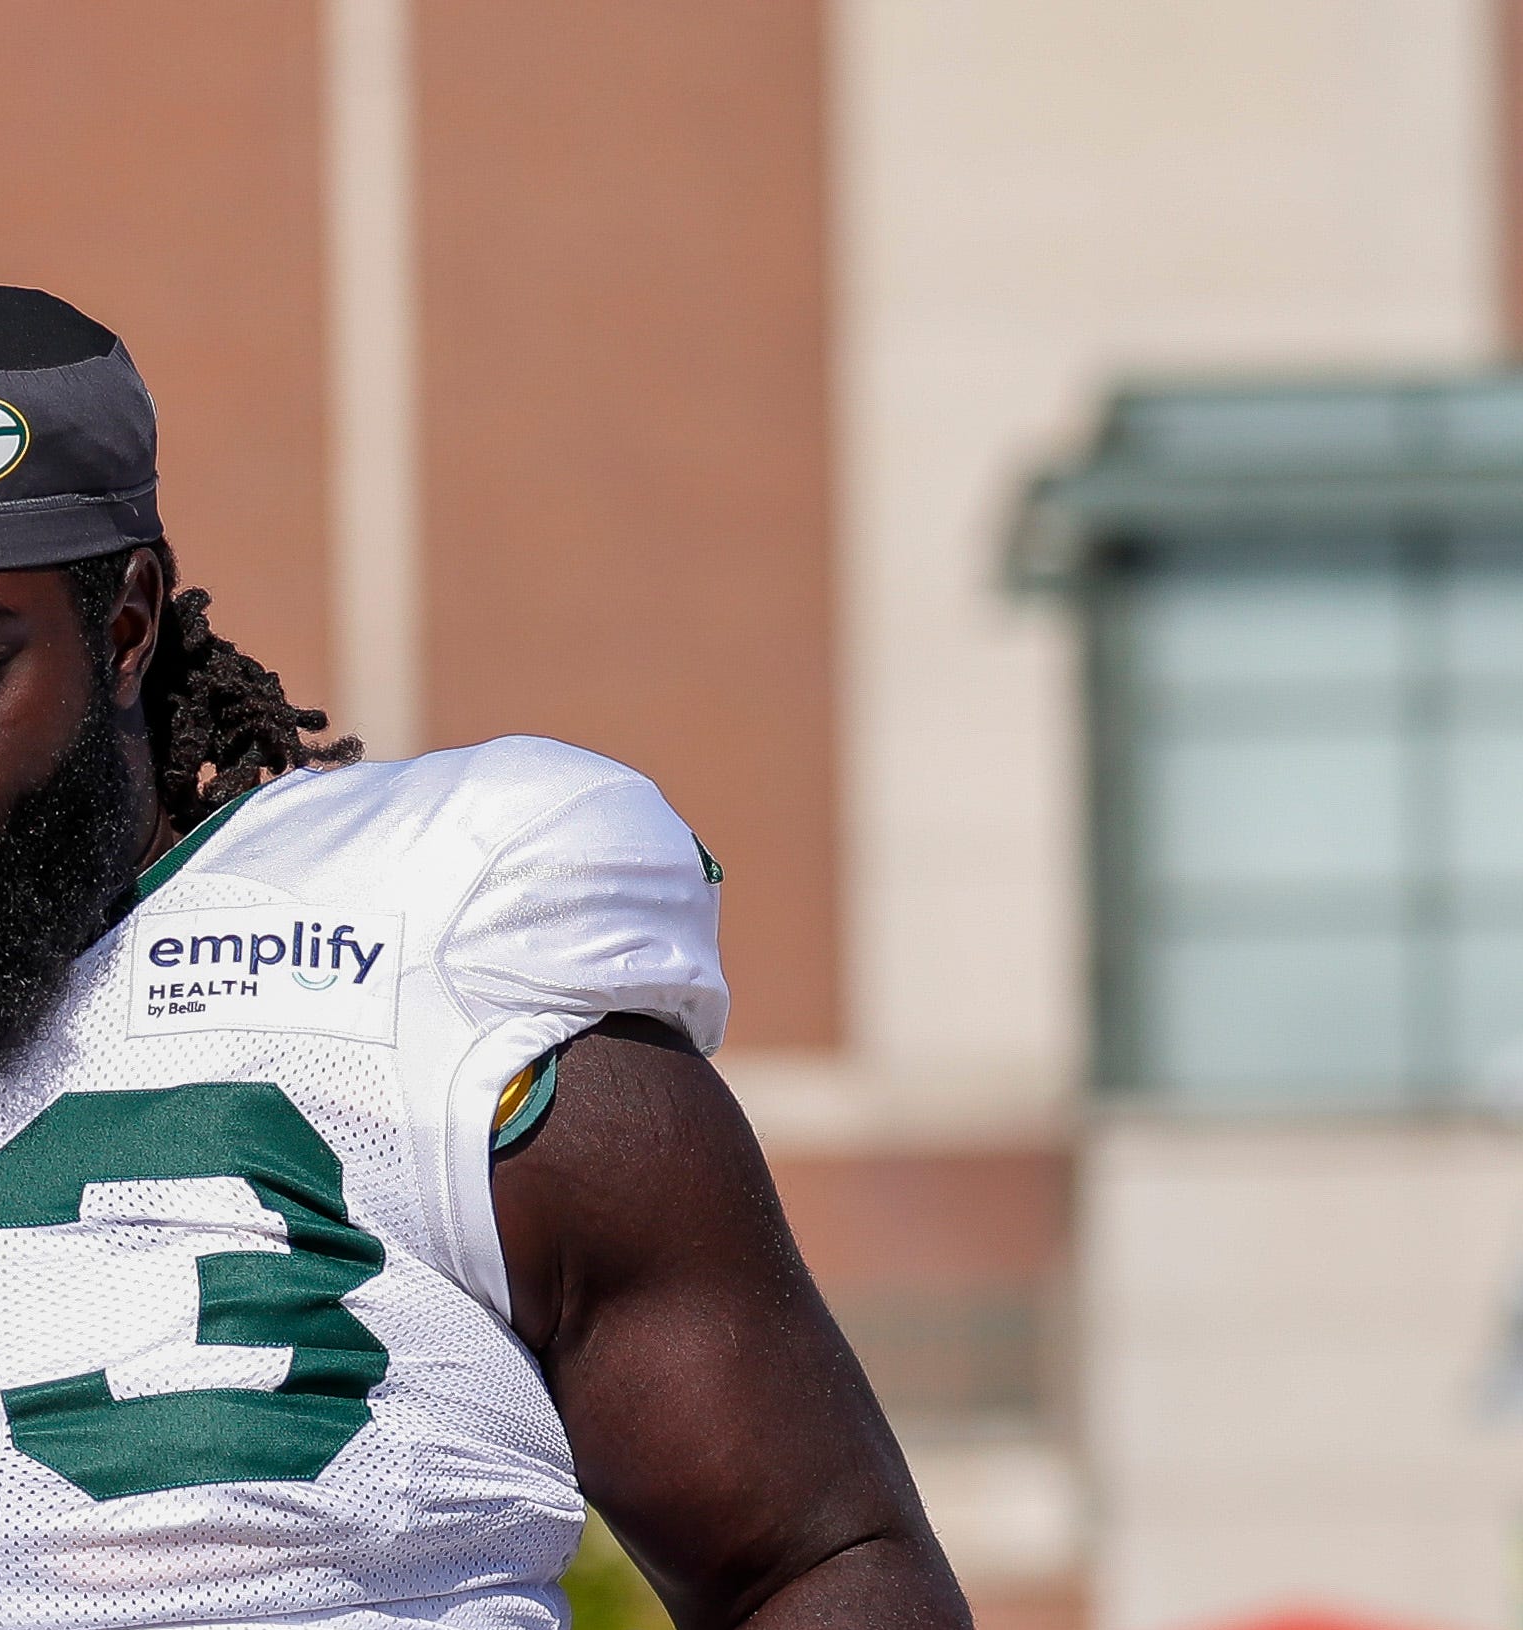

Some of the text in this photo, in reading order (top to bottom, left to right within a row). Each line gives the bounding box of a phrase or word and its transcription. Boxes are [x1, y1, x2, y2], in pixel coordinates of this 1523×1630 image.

[148, 920, 386, 985] emplify
[148, 979, 258, 1001] HEALTH
[147, 1003, 165, 1019] by
